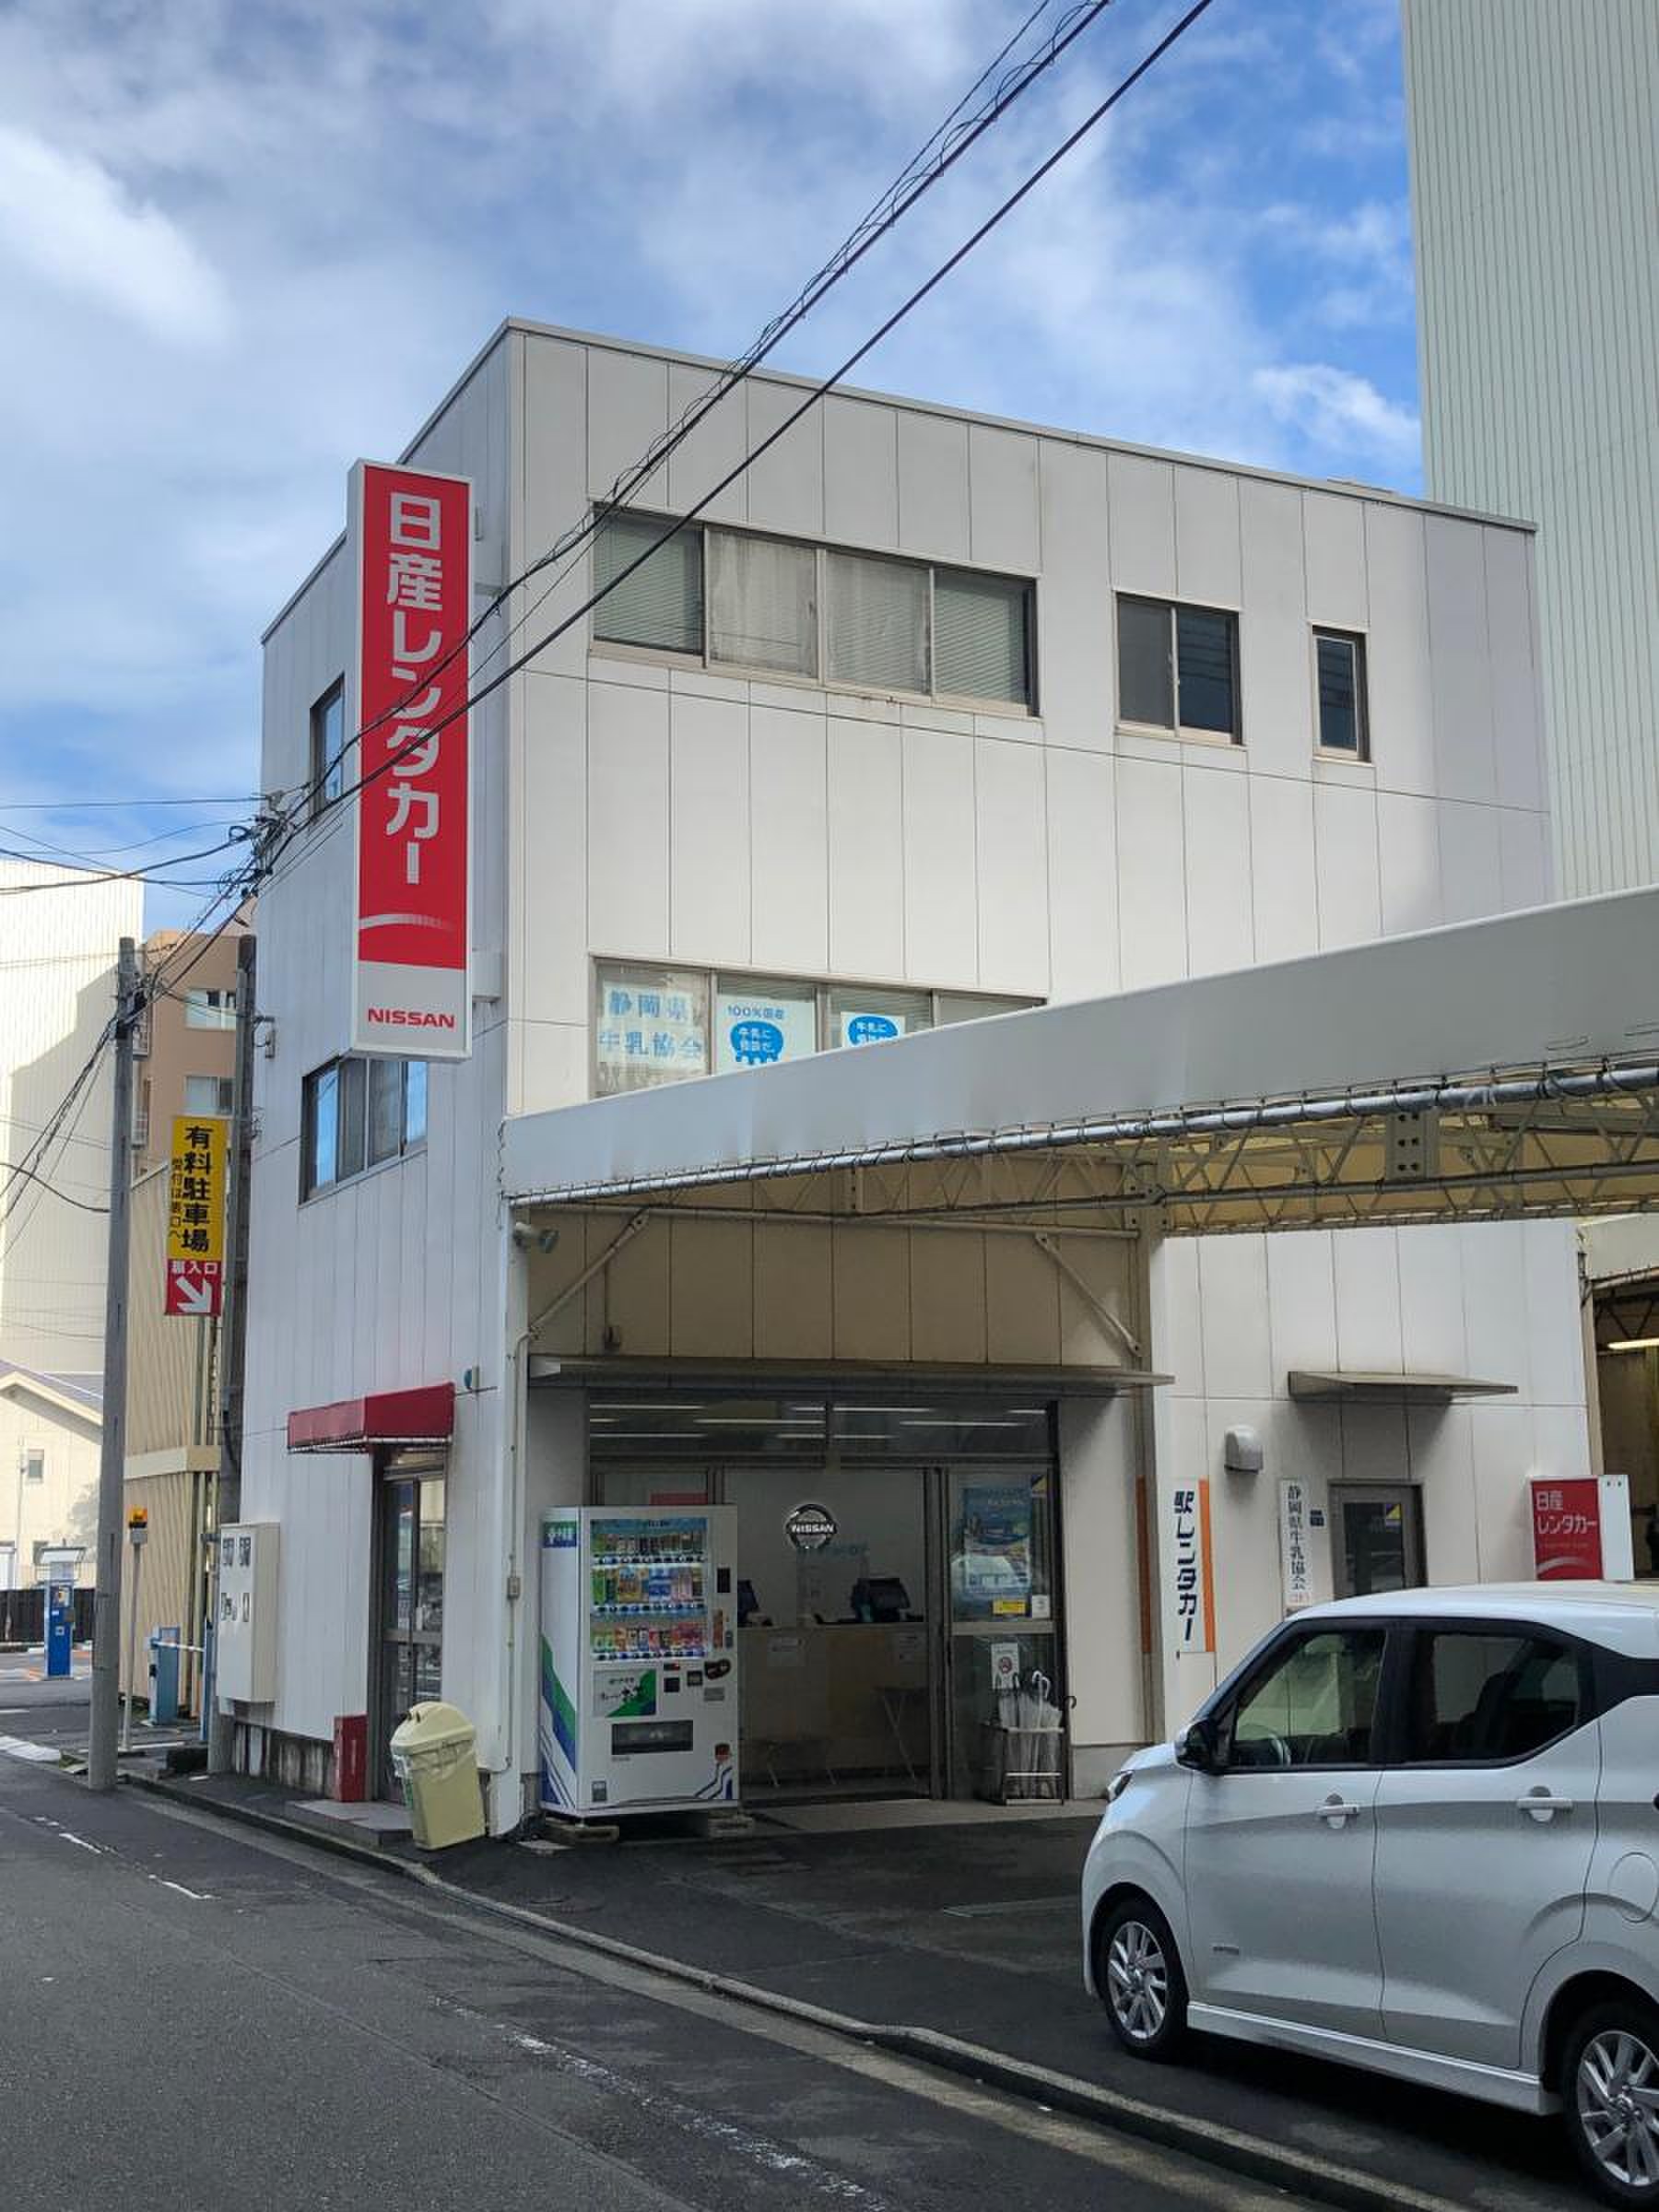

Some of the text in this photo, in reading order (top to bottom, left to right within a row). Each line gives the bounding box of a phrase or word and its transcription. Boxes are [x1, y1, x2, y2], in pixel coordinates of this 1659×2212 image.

[386, 491, 443, 885] 日産レンタカー
[368, 1008, 455, 1029] NISSAN
[182, 1125, 213, 1253] 有料駐車場
[1535, 1490, 1563, 1511] 日産
[792, 1524, 834, 1534] NISSAN
[1537, 1513, 1597, 1535] レンタカー
[1174, 1491, 1196, 1641] 駅レンタカー
